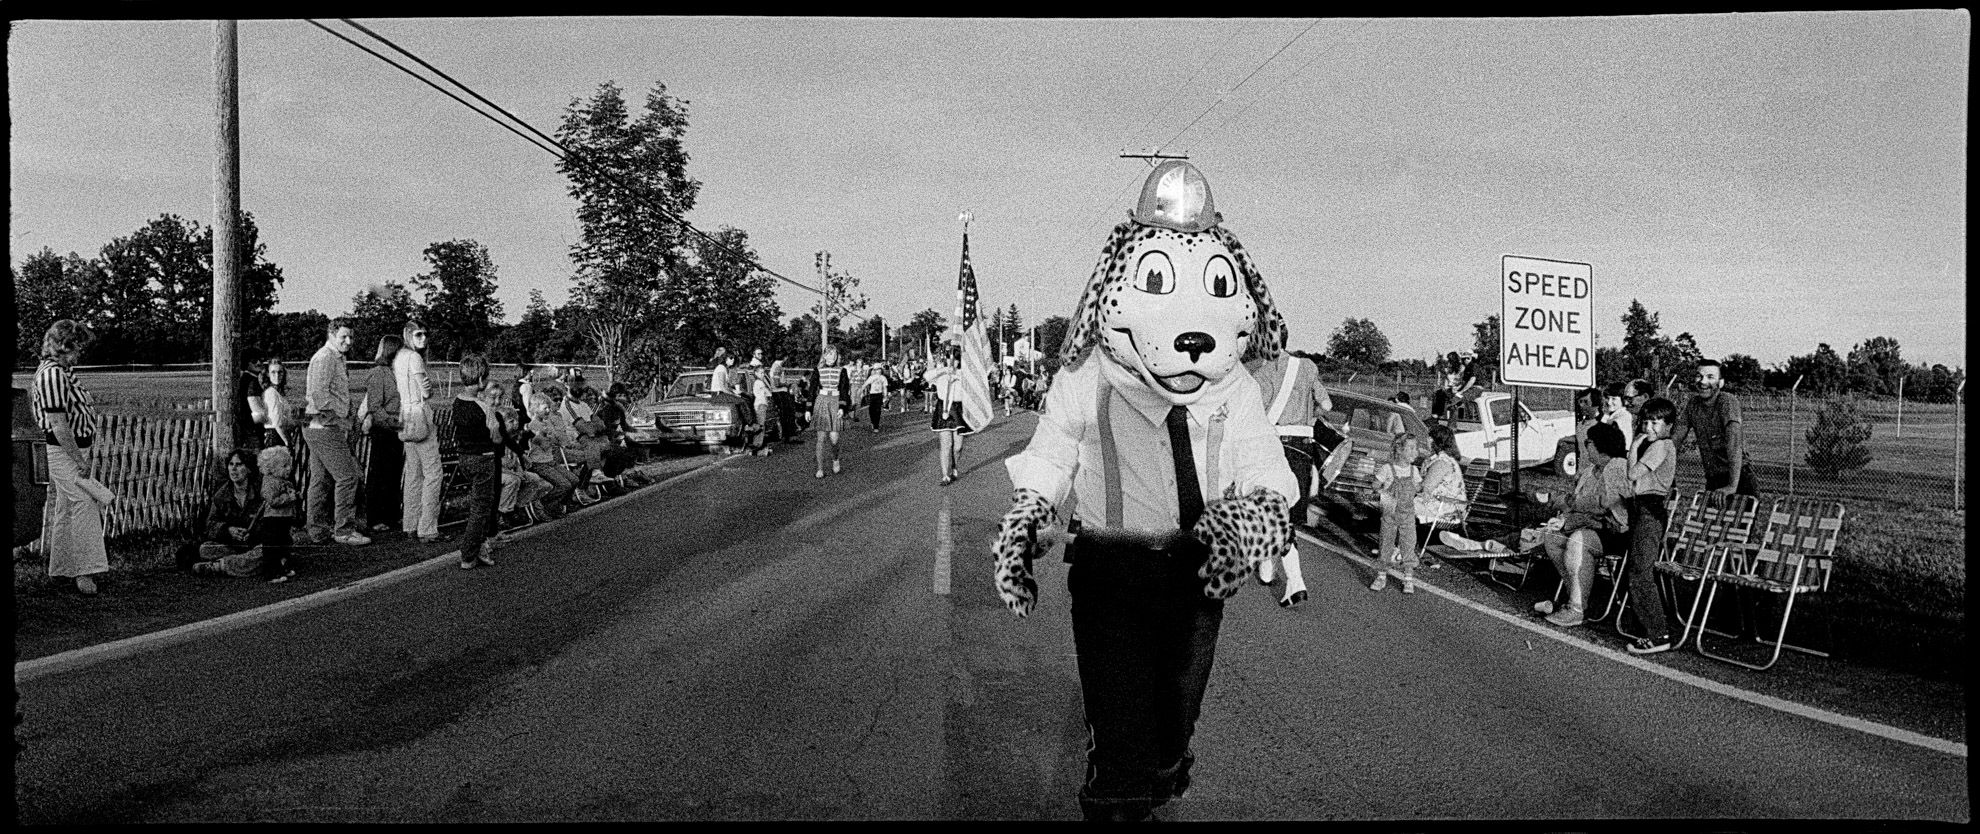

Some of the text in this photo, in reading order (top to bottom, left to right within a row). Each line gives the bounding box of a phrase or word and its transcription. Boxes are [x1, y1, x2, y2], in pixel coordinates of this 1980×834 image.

[1508, 271, 1588, 299] SPEED
[1515, 306, 1580, 334] ZONE
[1507, 342, 1589, 370] AHEAD
